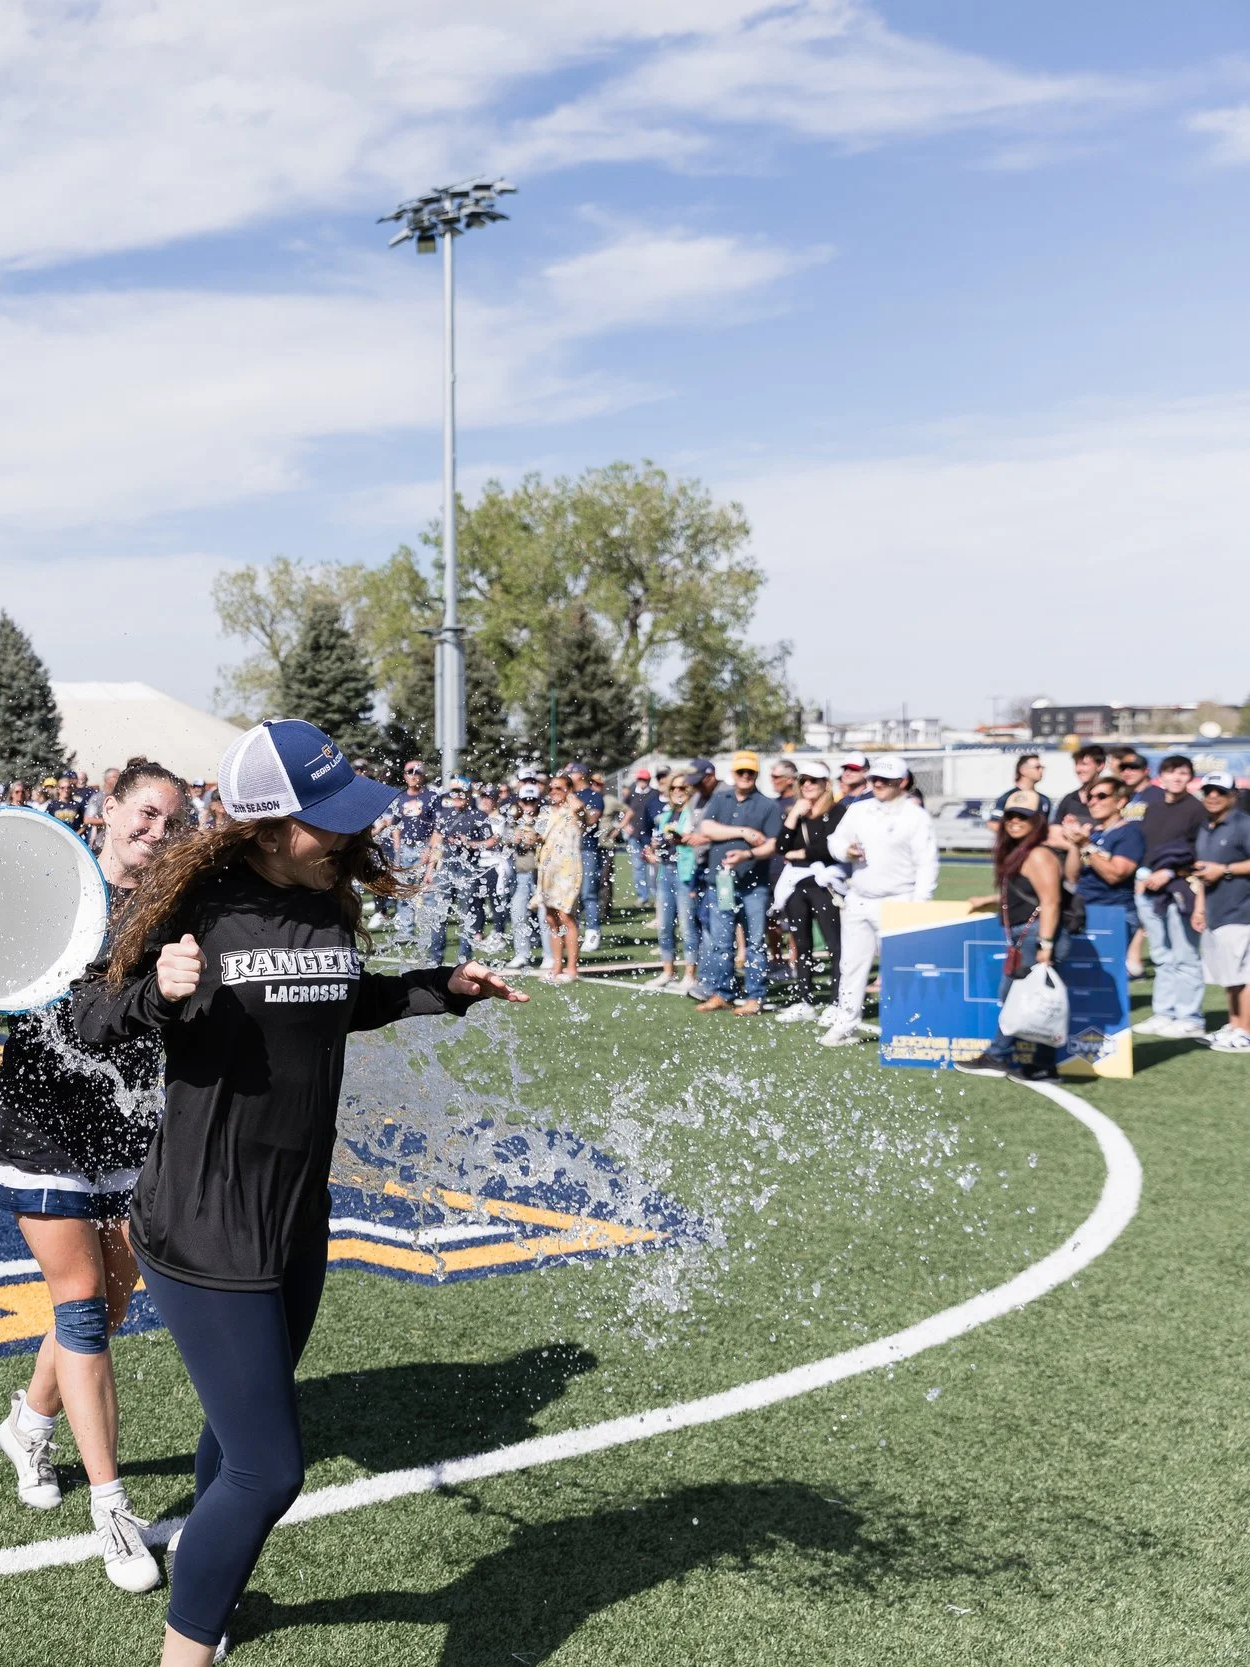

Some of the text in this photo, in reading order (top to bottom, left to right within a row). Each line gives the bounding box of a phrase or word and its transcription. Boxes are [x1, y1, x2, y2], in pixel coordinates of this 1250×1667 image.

[311, 764, 332, 780] REGIS
[246, 800, 280, 813] SEASON
[264, 983, 349, 1003] LACROSSE
